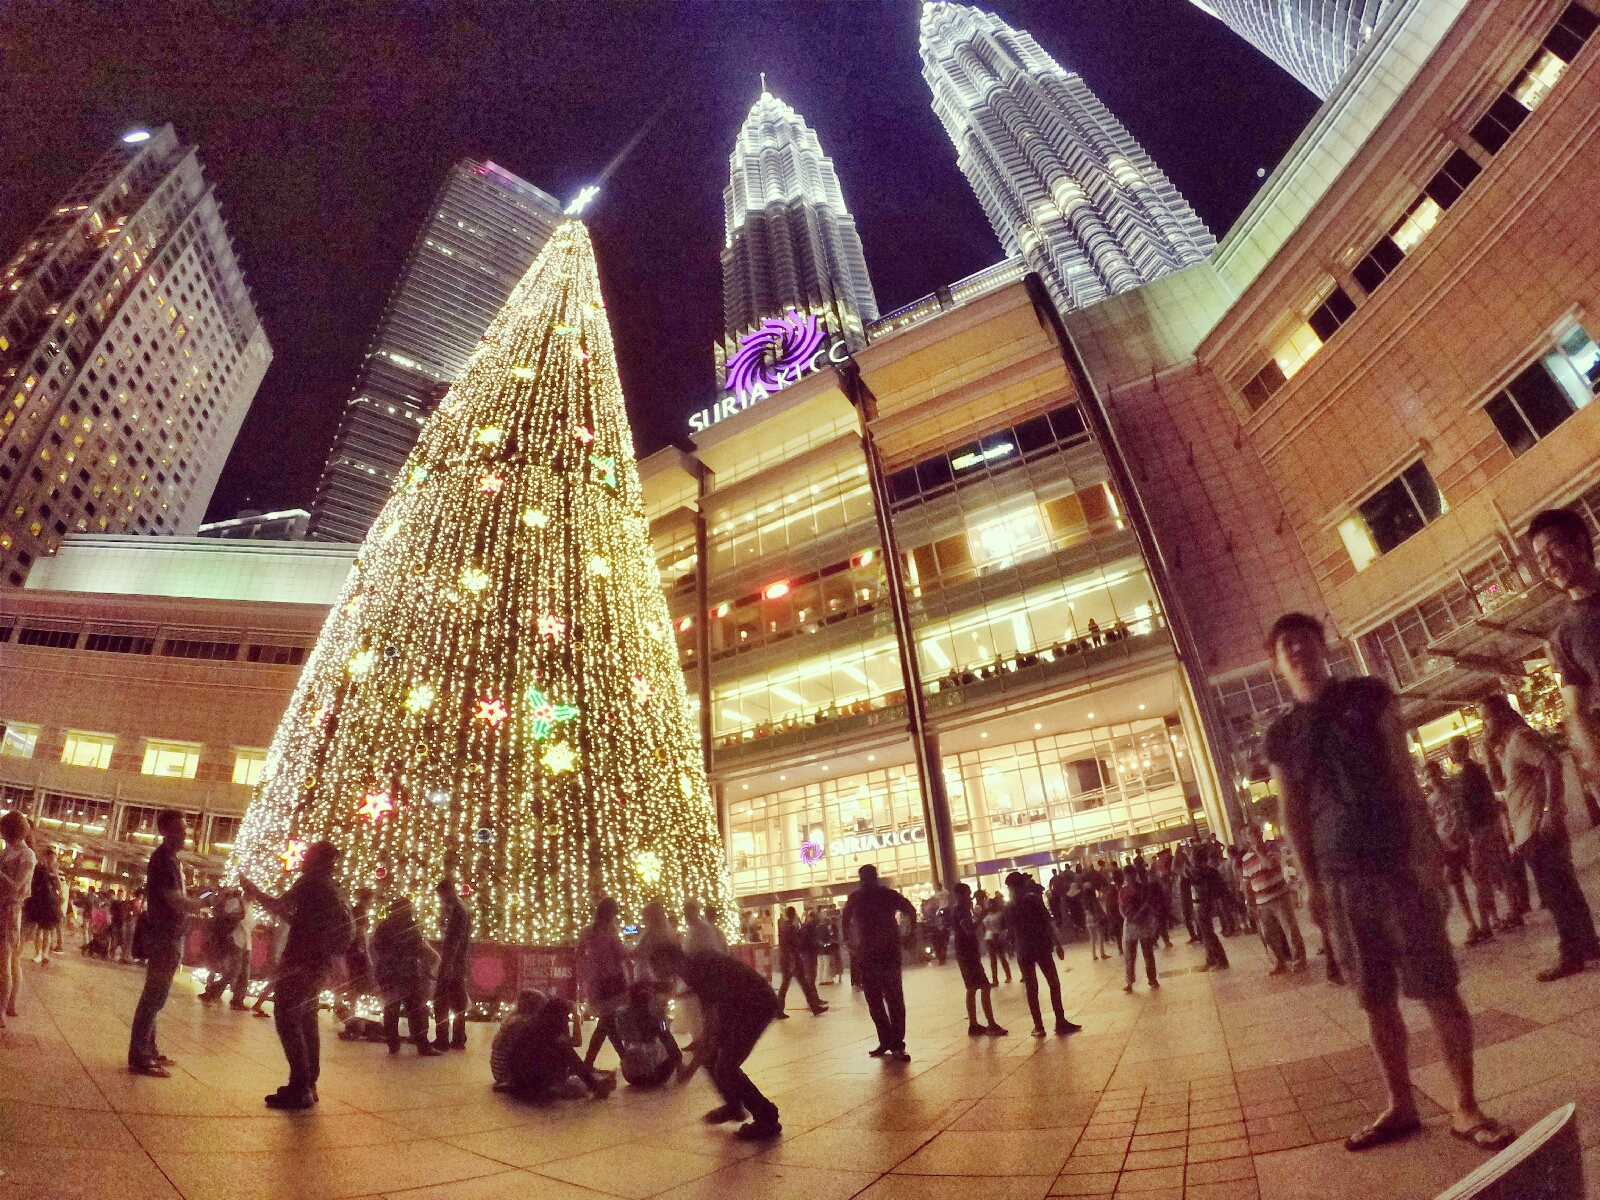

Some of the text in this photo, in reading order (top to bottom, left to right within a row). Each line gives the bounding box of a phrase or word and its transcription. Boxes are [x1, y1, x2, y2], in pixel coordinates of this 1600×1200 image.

[688, 383, 769, 434] SURIA
[830, 827, 922, 856] SURIA KLCC
